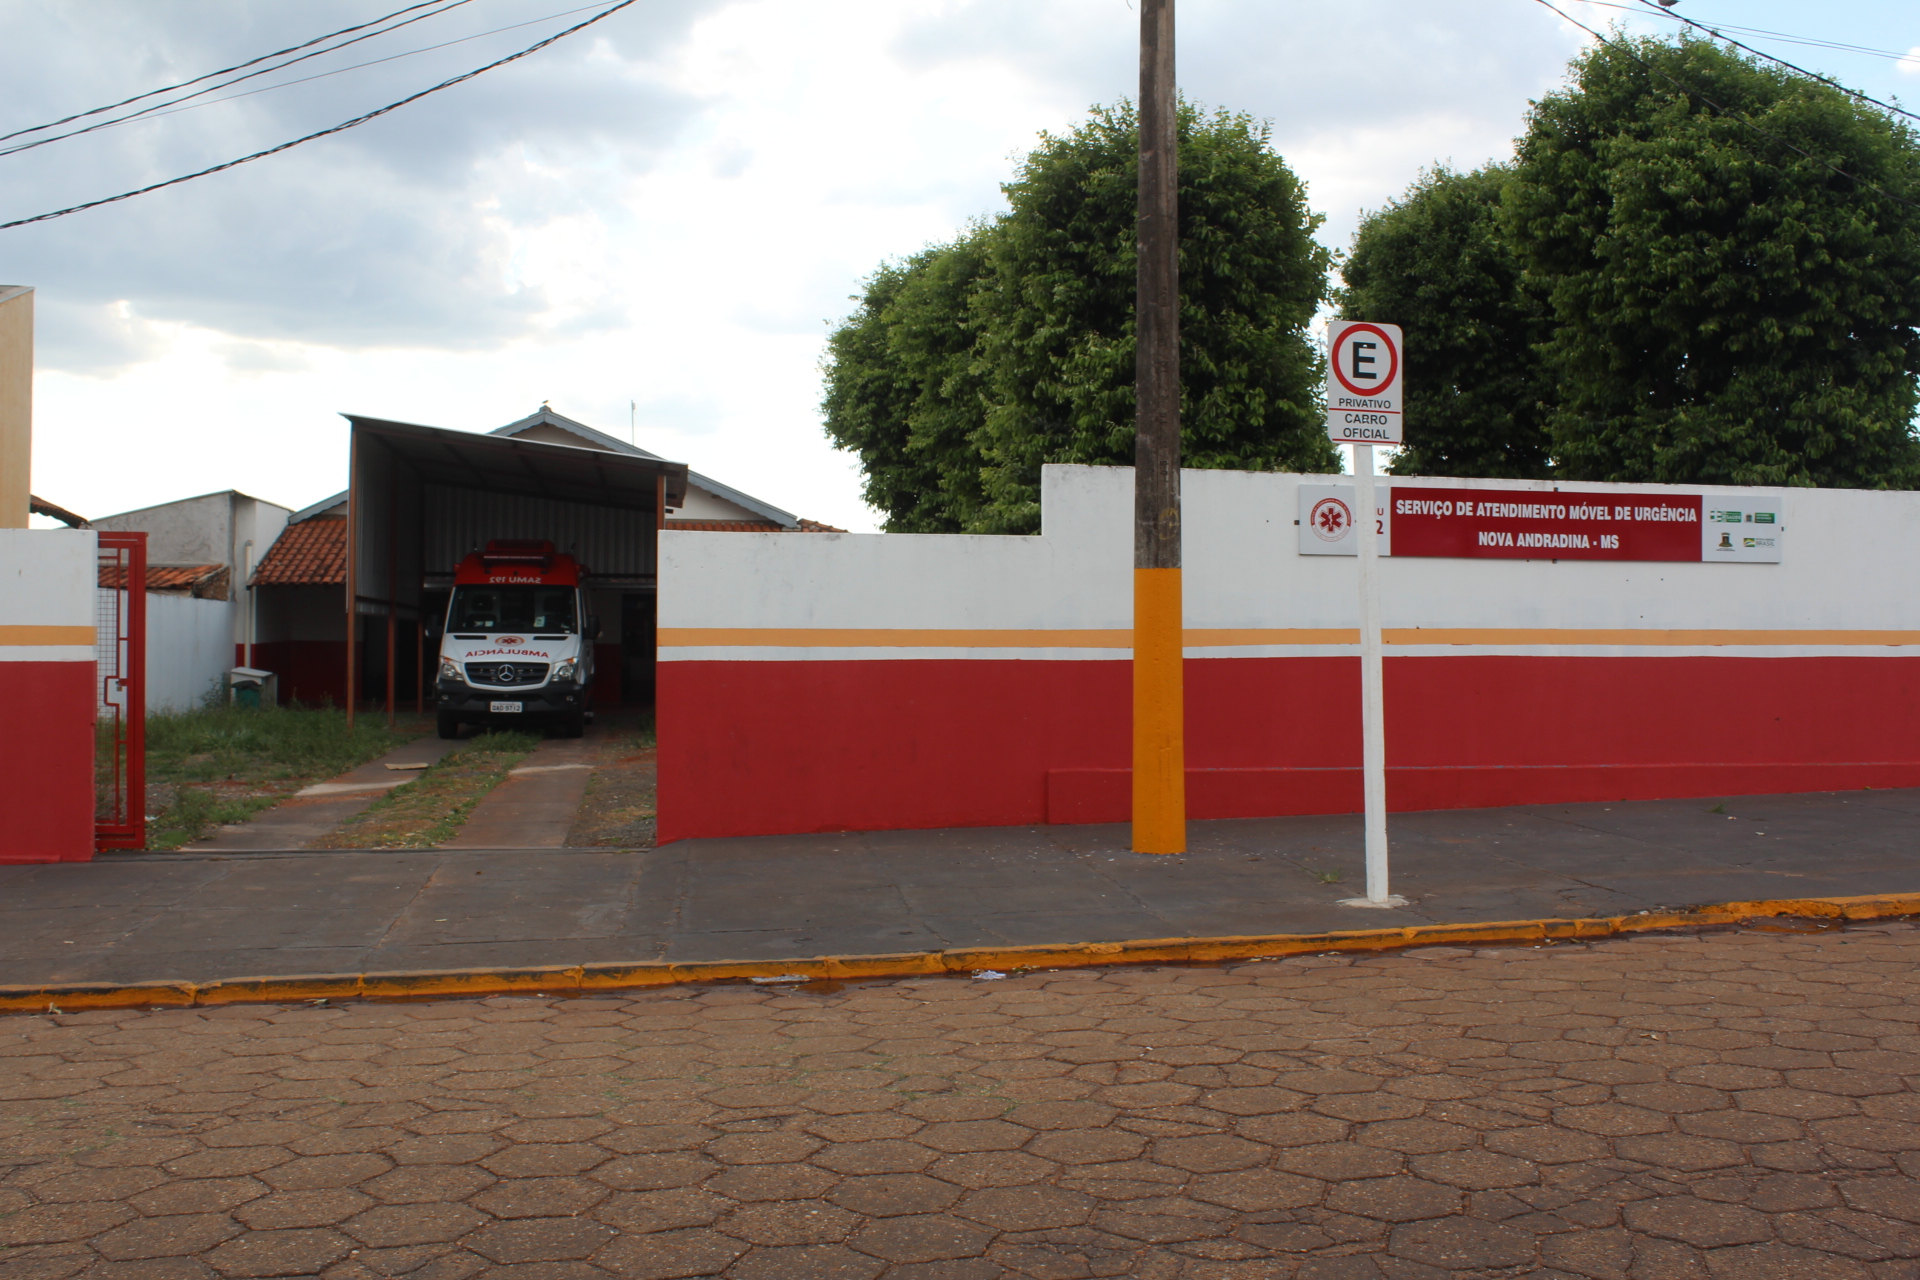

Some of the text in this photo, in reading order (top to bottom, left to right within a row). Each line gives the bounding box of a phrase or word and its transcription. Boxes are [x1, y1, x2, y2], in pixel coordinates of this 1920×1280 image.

[1352, 341, 1377, 379] E
[1338, 397, 1391, 409] PRIVATIVO
[1344, 413, 1388, 425] CARRO
[1343, 427, 1389, 439] OFICIAL
[1395, 499, 1453, 519] SERVIÇO
[1456, 501, 1474, 516] DE
[1476, 502, 1566, 519] ATENDIMENTO
[1569, 502, 1611, 520] MÓVEL
[1614, 506, 1631, 520] DE
[1634, 503, 1697, 522] URGÊNCIA
[1478, 531, 1514, 547] NOVA
[1516, 532, 1590, 549] ANDRADINA
[1600, 534, 1619, 549] MS
